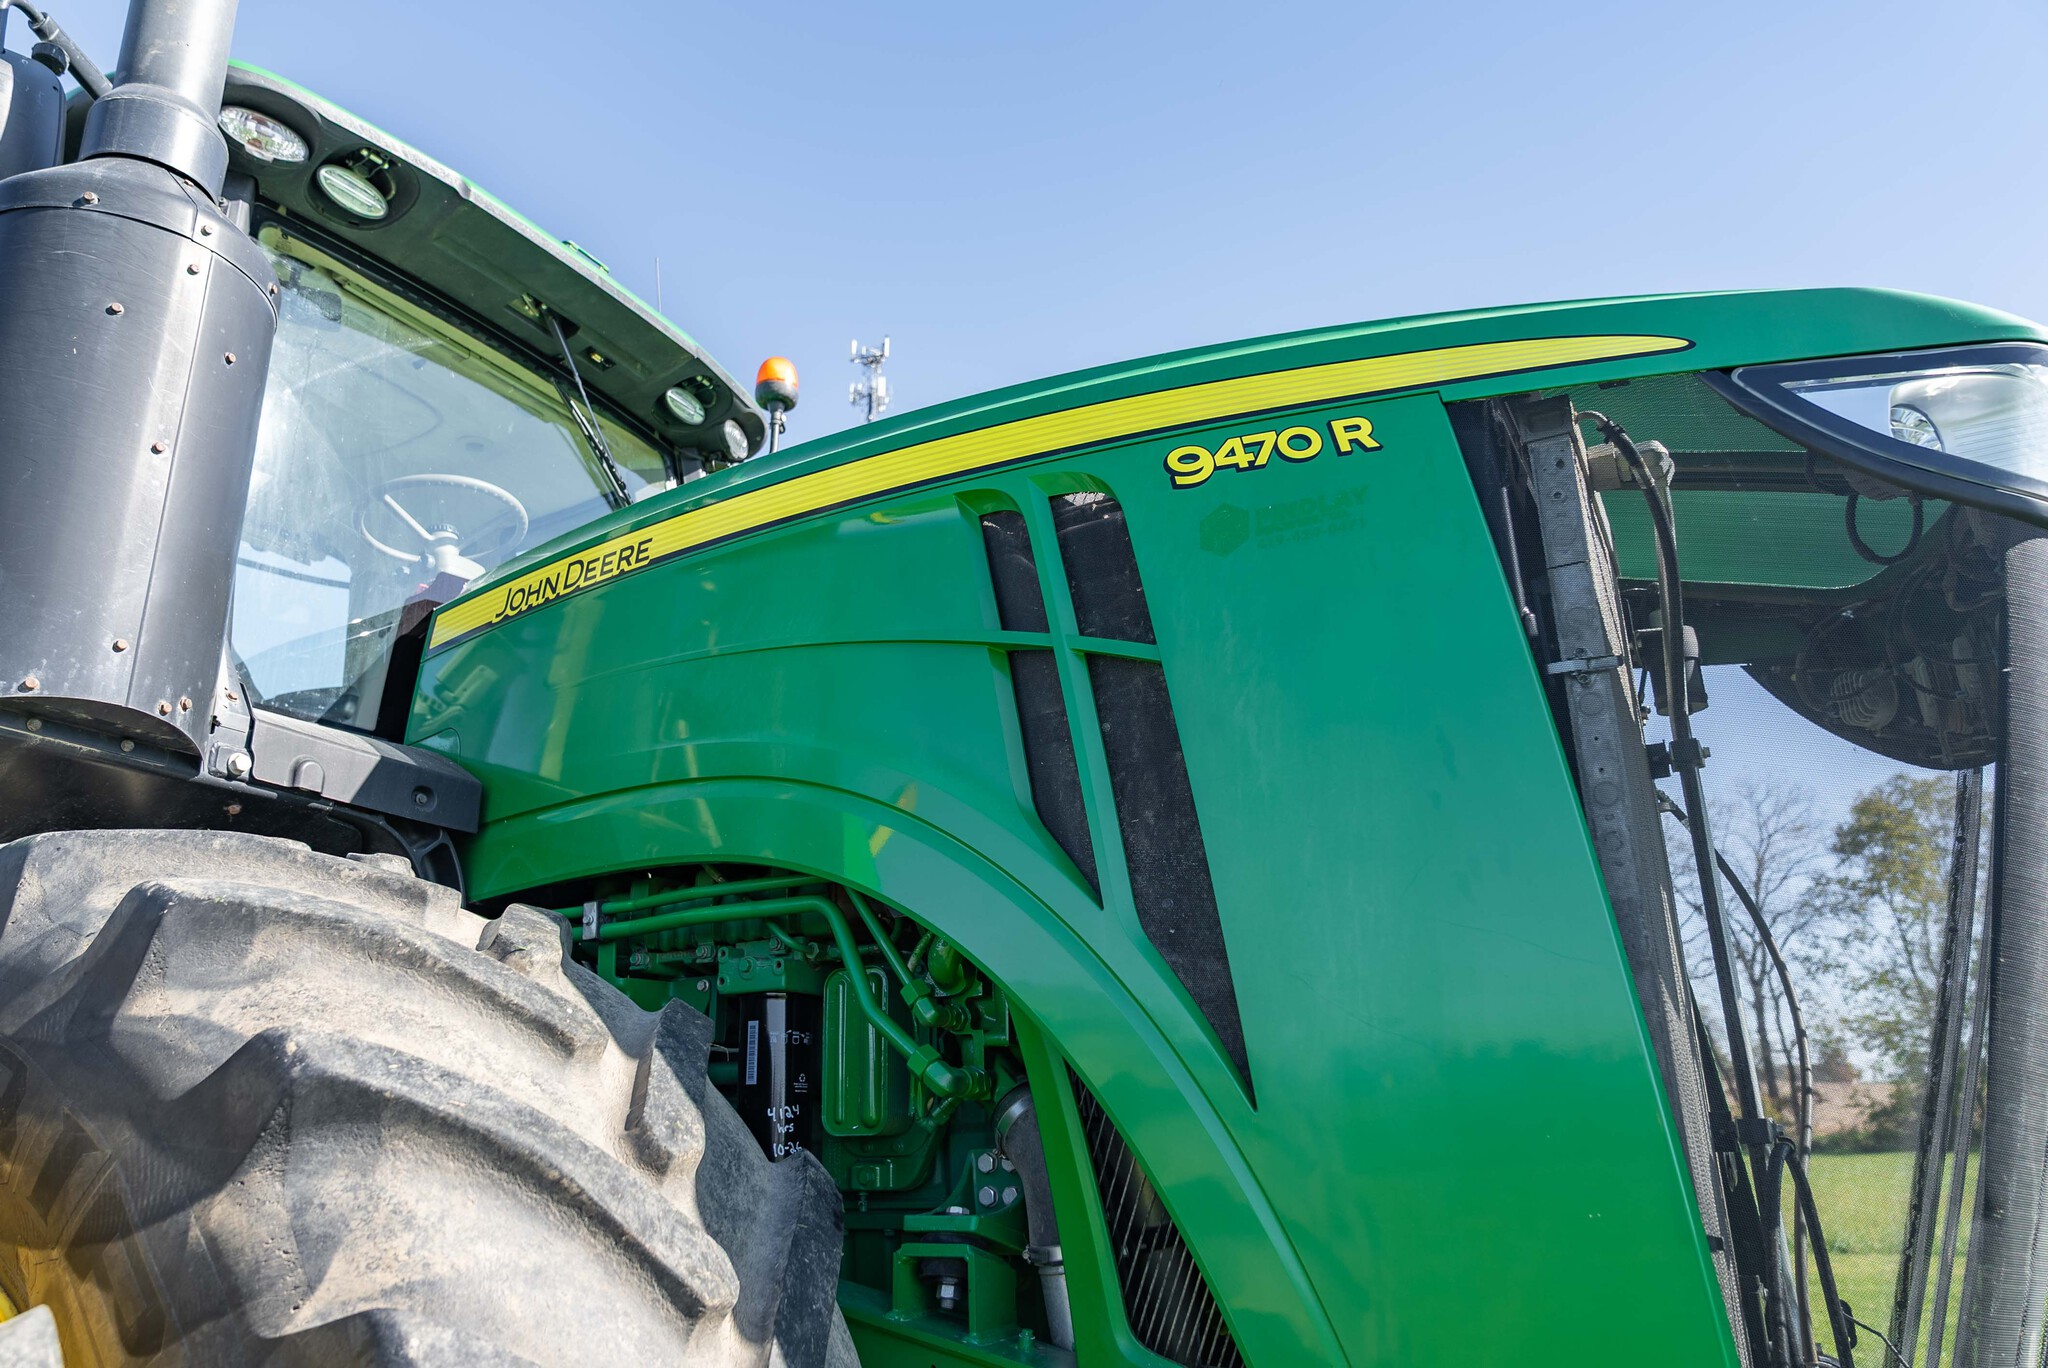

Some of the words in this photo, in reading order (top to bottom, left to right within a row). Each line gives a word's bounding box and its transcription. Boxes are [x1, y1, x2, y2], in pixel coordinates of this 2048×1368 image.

[1163, 426, 1324, 489] 9470
[1326, 416, 1384, 457] R
[494, 572, 561, 619] JOHN
[563, 538, 653, 590] DEERE
[767, 1104, 800, 1122] 4124
[777, 1122, 794, 1134] hrs
